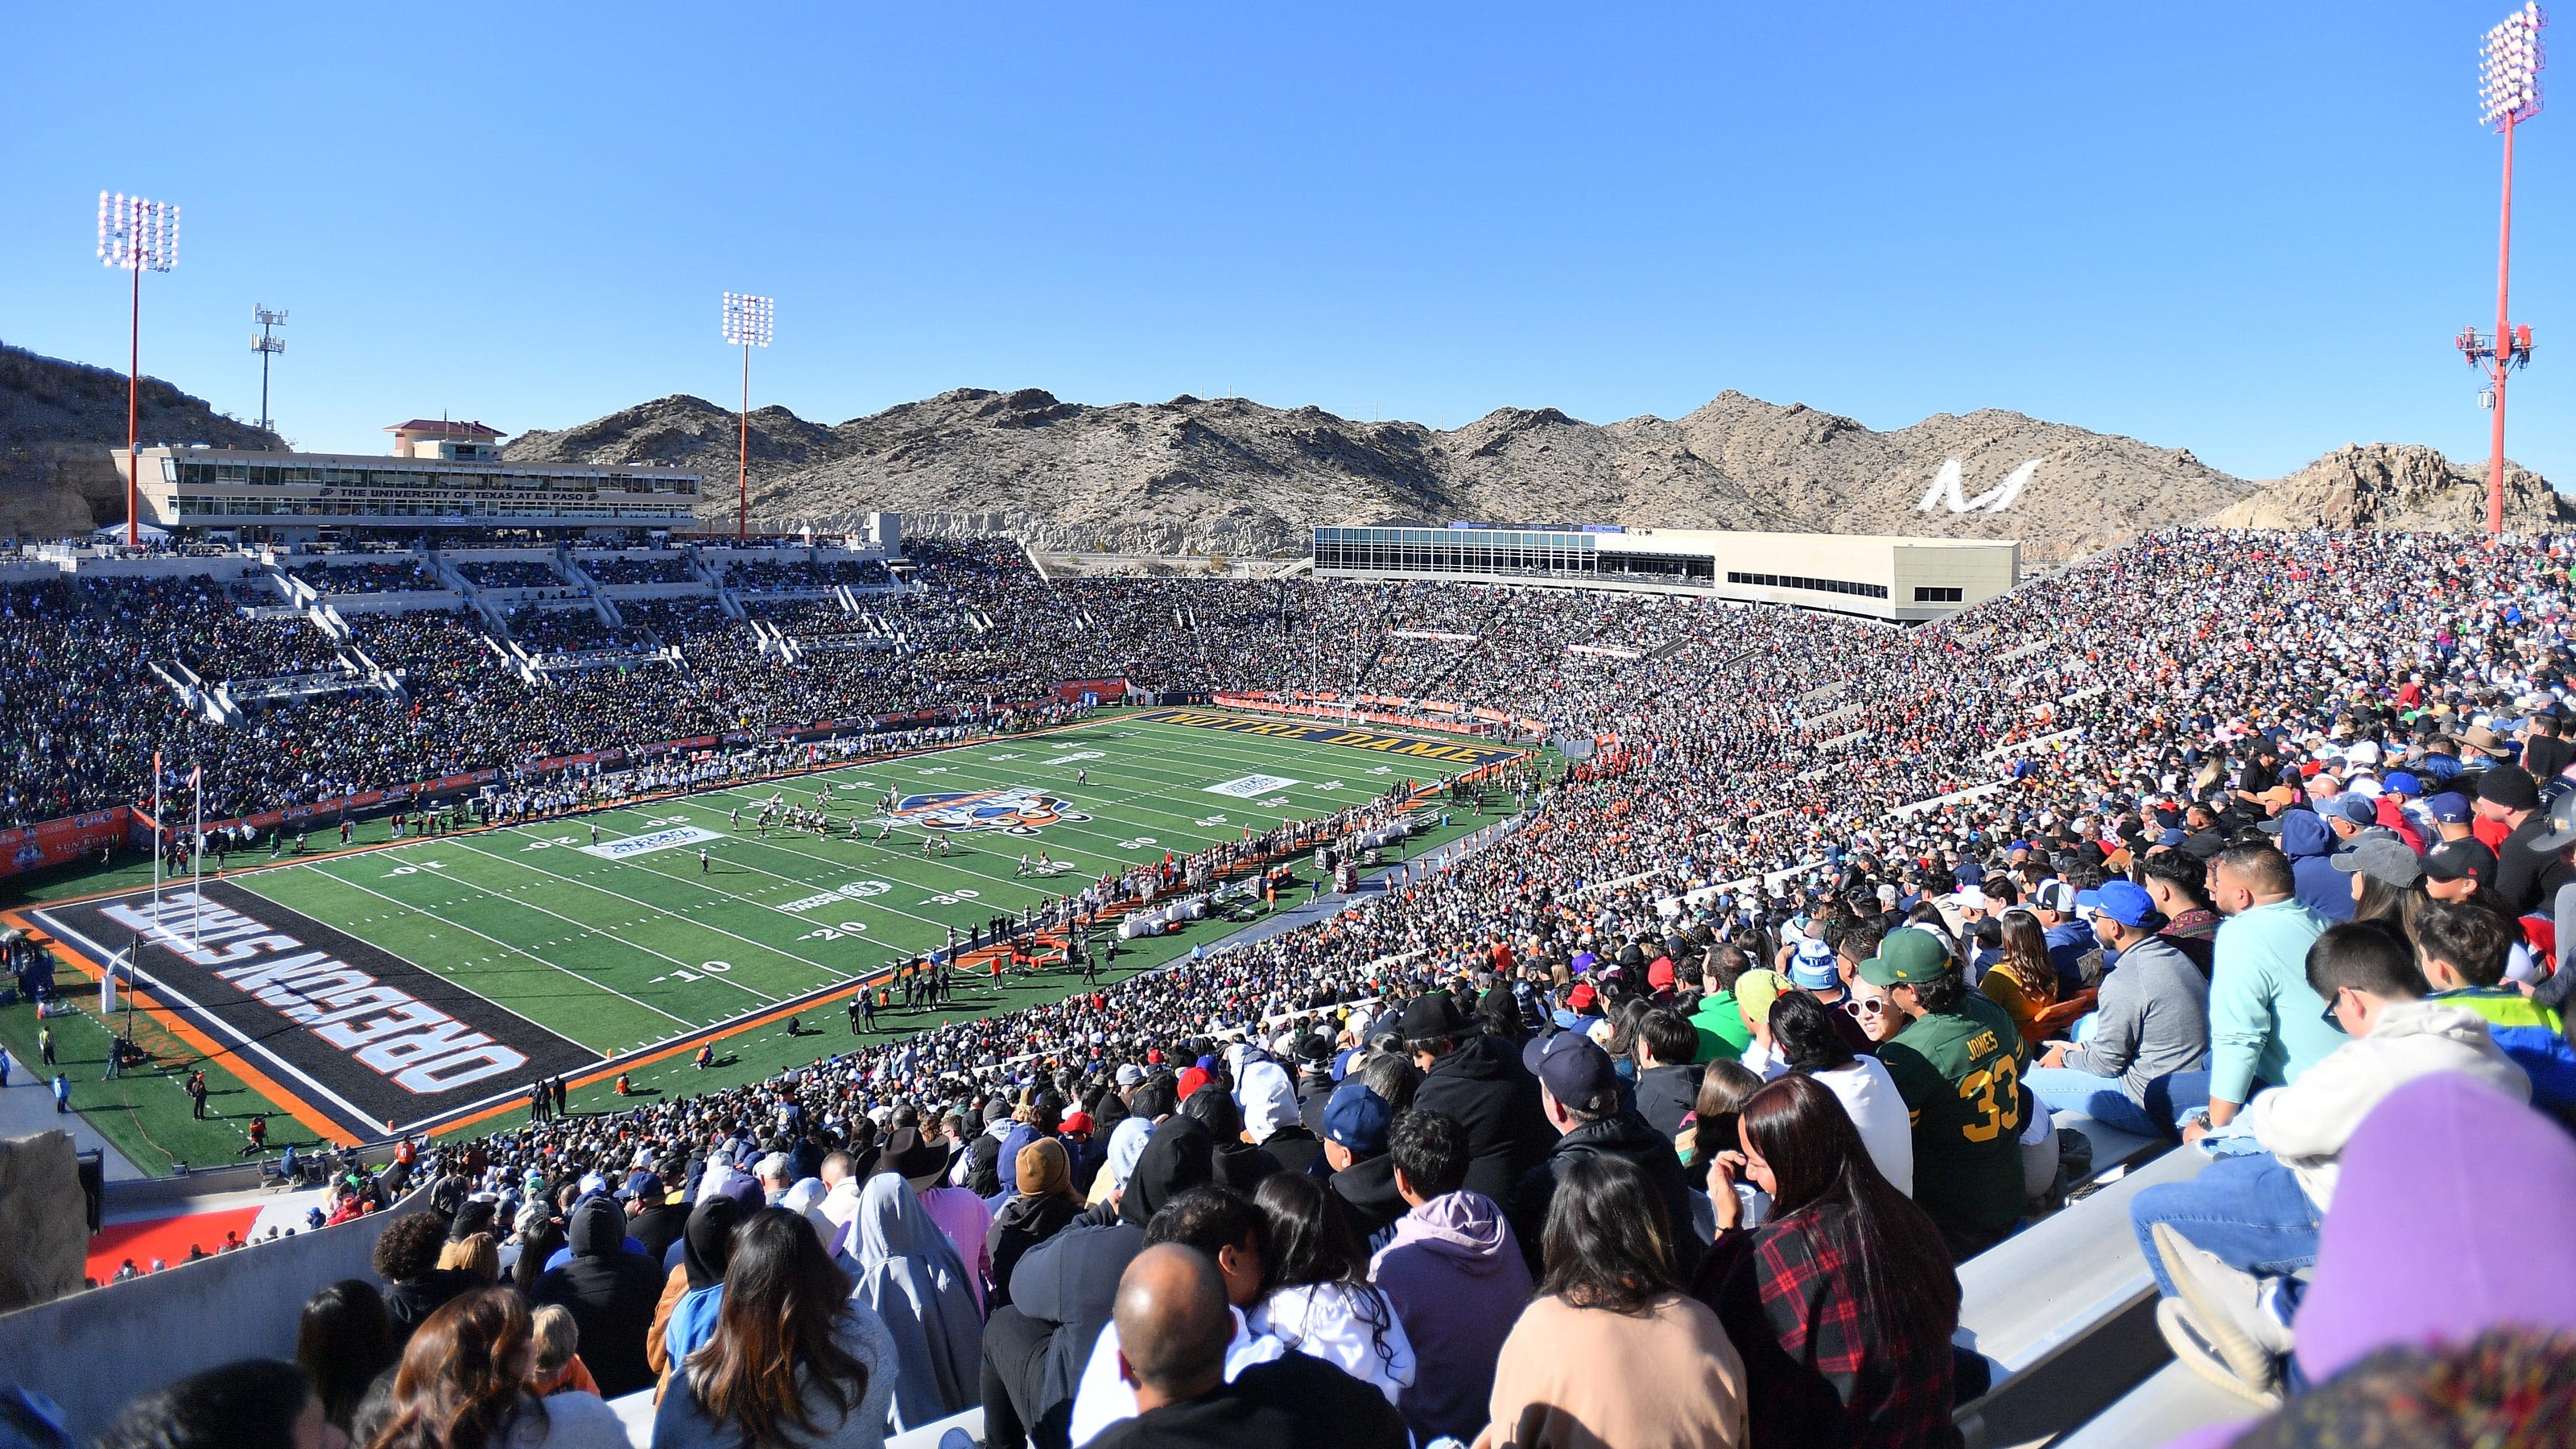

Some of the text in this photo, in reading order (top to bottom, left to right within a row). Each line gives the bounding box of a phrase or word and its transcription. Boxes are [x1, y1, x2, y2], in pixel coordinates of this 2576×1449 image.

[341, 489, 366, 497] THE
[370, 489, 449, 498] UNIVERSITY
[1158, 712, 1493, 762] NOTRE DAME
[646, 815, 691, 827] 30
[530, 836, 579, 849] 20
[393, 860, 448, 874] 10
[783, 895, 845, 912] BOWL
[931, 889, 980, 906] 30
[811, 921, 867, 941] 20
[670, 960, 732, 983] 10
[98, 891, 530, 1095] OREGON STATE
[1966, 1030, 1999, 1061] JONES
[1959, 1054, 2019, 1143] 33
